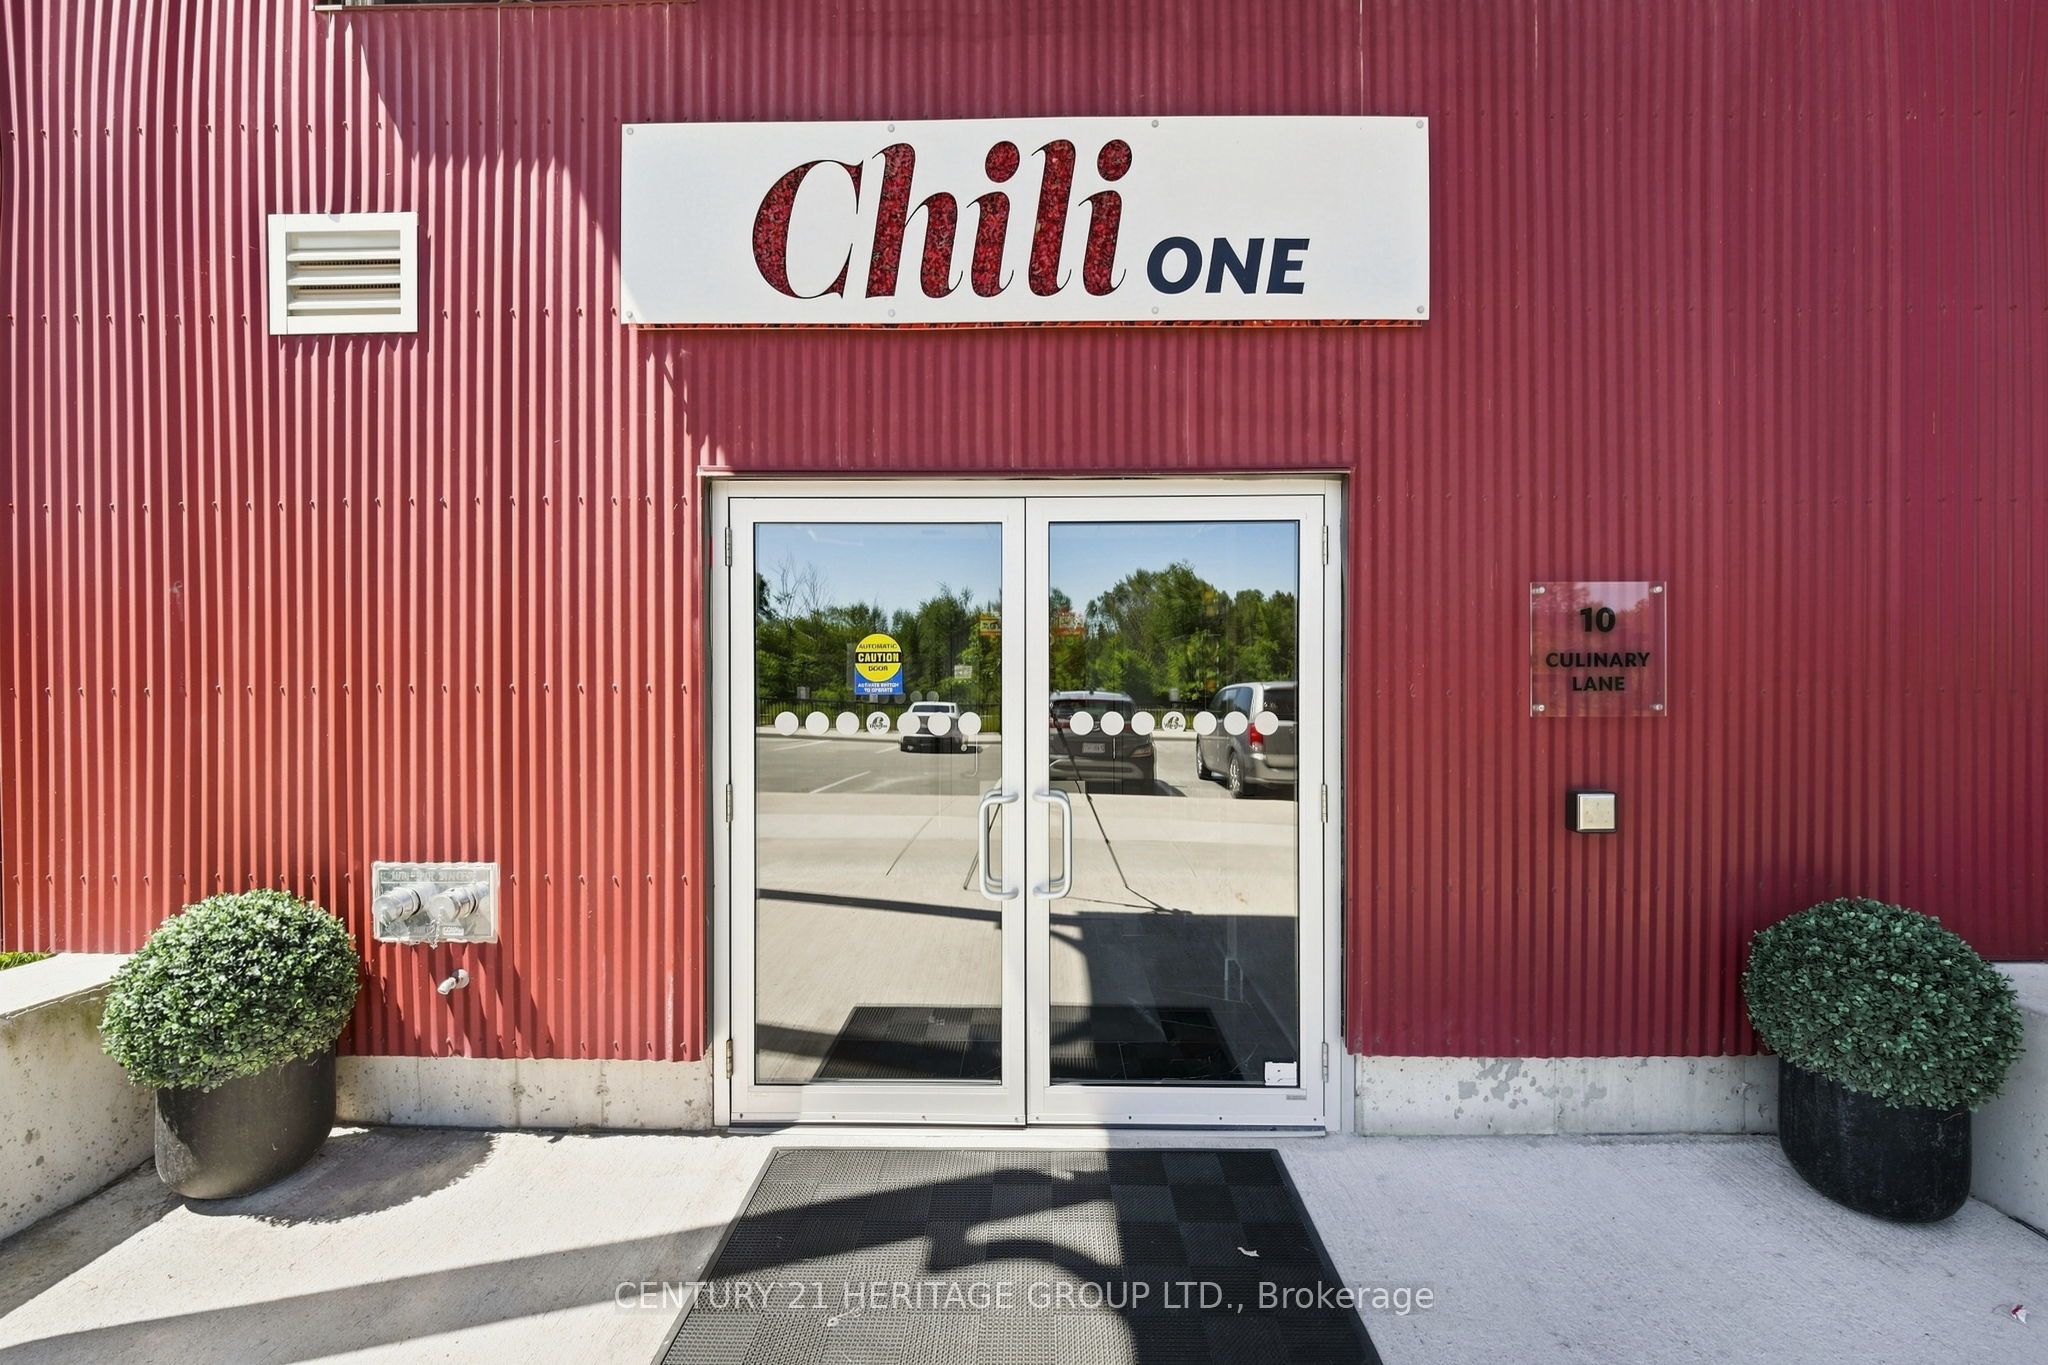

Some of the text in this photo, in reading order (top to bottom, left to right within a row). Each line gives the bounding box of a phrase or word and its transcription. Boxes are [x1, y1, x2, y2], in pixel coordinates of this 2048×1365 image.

[751, 137, 1310, 300] Chili ONE
[1580, 606, 1616, 633] 10
[858, 652, 899, 662] CAUTION
[1545, 652, 1650, 668] CULINARY
[1572, 676, 1625, 691] LANE
